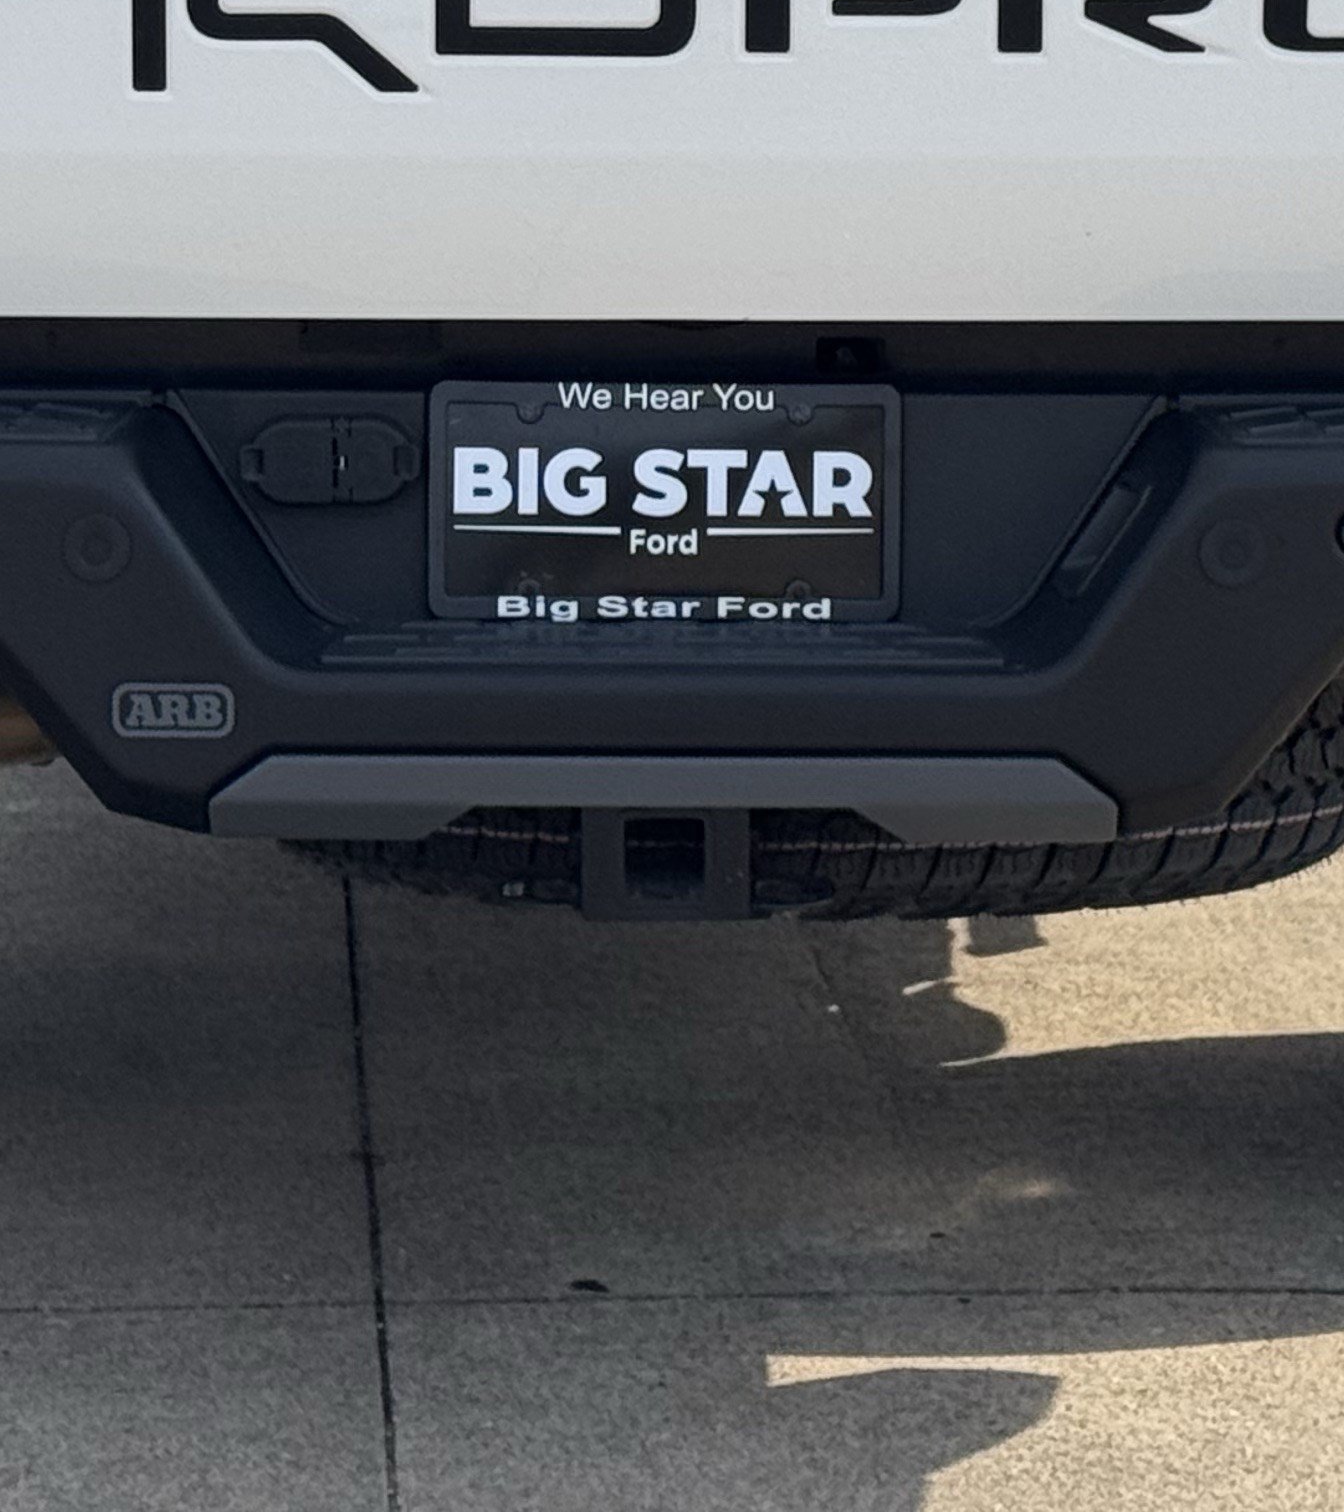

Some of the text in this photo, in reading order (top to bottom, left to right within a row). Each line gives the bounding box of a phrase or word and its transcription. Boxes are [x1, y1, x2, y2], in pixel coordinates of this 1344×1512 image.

[559, 383, 774, 411] We Hear You
[453, 447, 873, 517] BIG STAR
[630, 529, 698, 555] Ford
[497, 595, 832, 622] Big Star Ford
[125, 693, 223, 727] ARB
